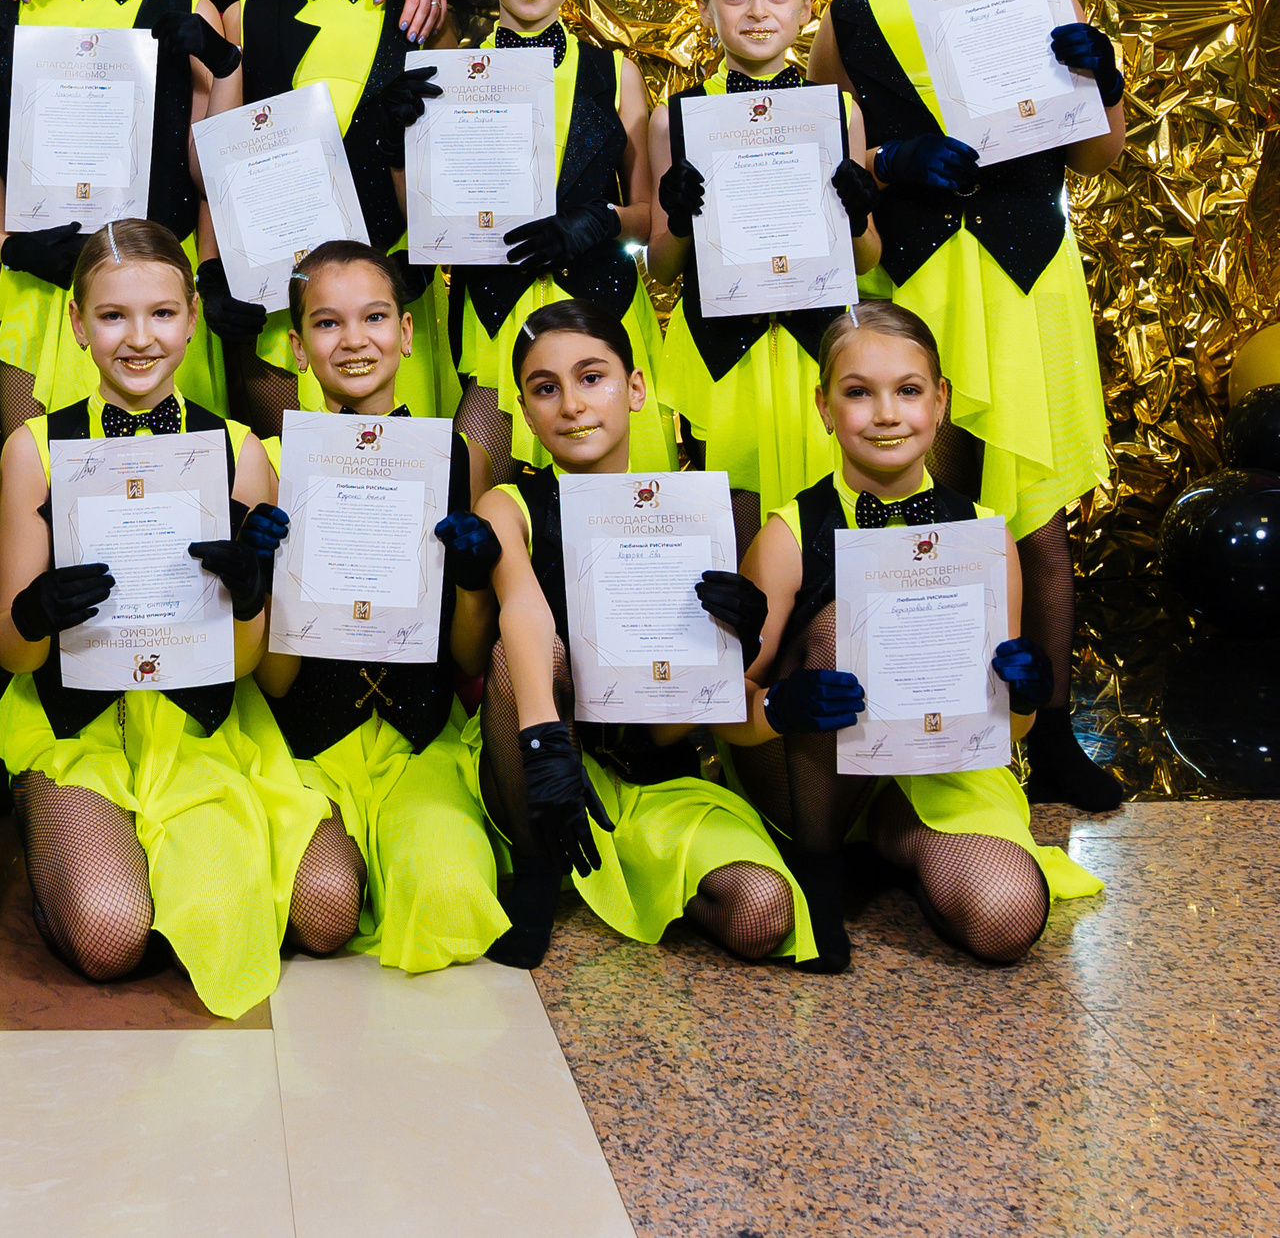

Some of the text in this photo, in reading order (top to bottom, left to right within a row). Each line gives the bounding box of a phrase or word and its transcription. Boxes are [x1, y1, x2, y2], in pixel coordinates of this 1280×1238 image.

[64, 69, 107, 79] ПИСЬМО
[457, 93, 501, 102] ПИСЬМО
[248, 137, 290, 155] ПИСЬМО
[740, 134, 786, 147] ПИСЬМО
[308, 454, 426, 469] БЛАГОДАРСТВЕННОЕ
[342, 466, 392, 477] ПИСЬМО
[588, 513, 708, 525] БЛАГОДАРСТВЕННОЕ
[623, 524, 674, 534] ПИСЬМО
[865, 561, 983, 581] БЛАГОДАРСТВЕННОЕ
[901, 575, 951, 588] ПИСЬМО
[120, 626, 171, 638] ПИСЬМО
[85, 633, 207, 649] БЛАГОДАРСТВЕННОЕ
